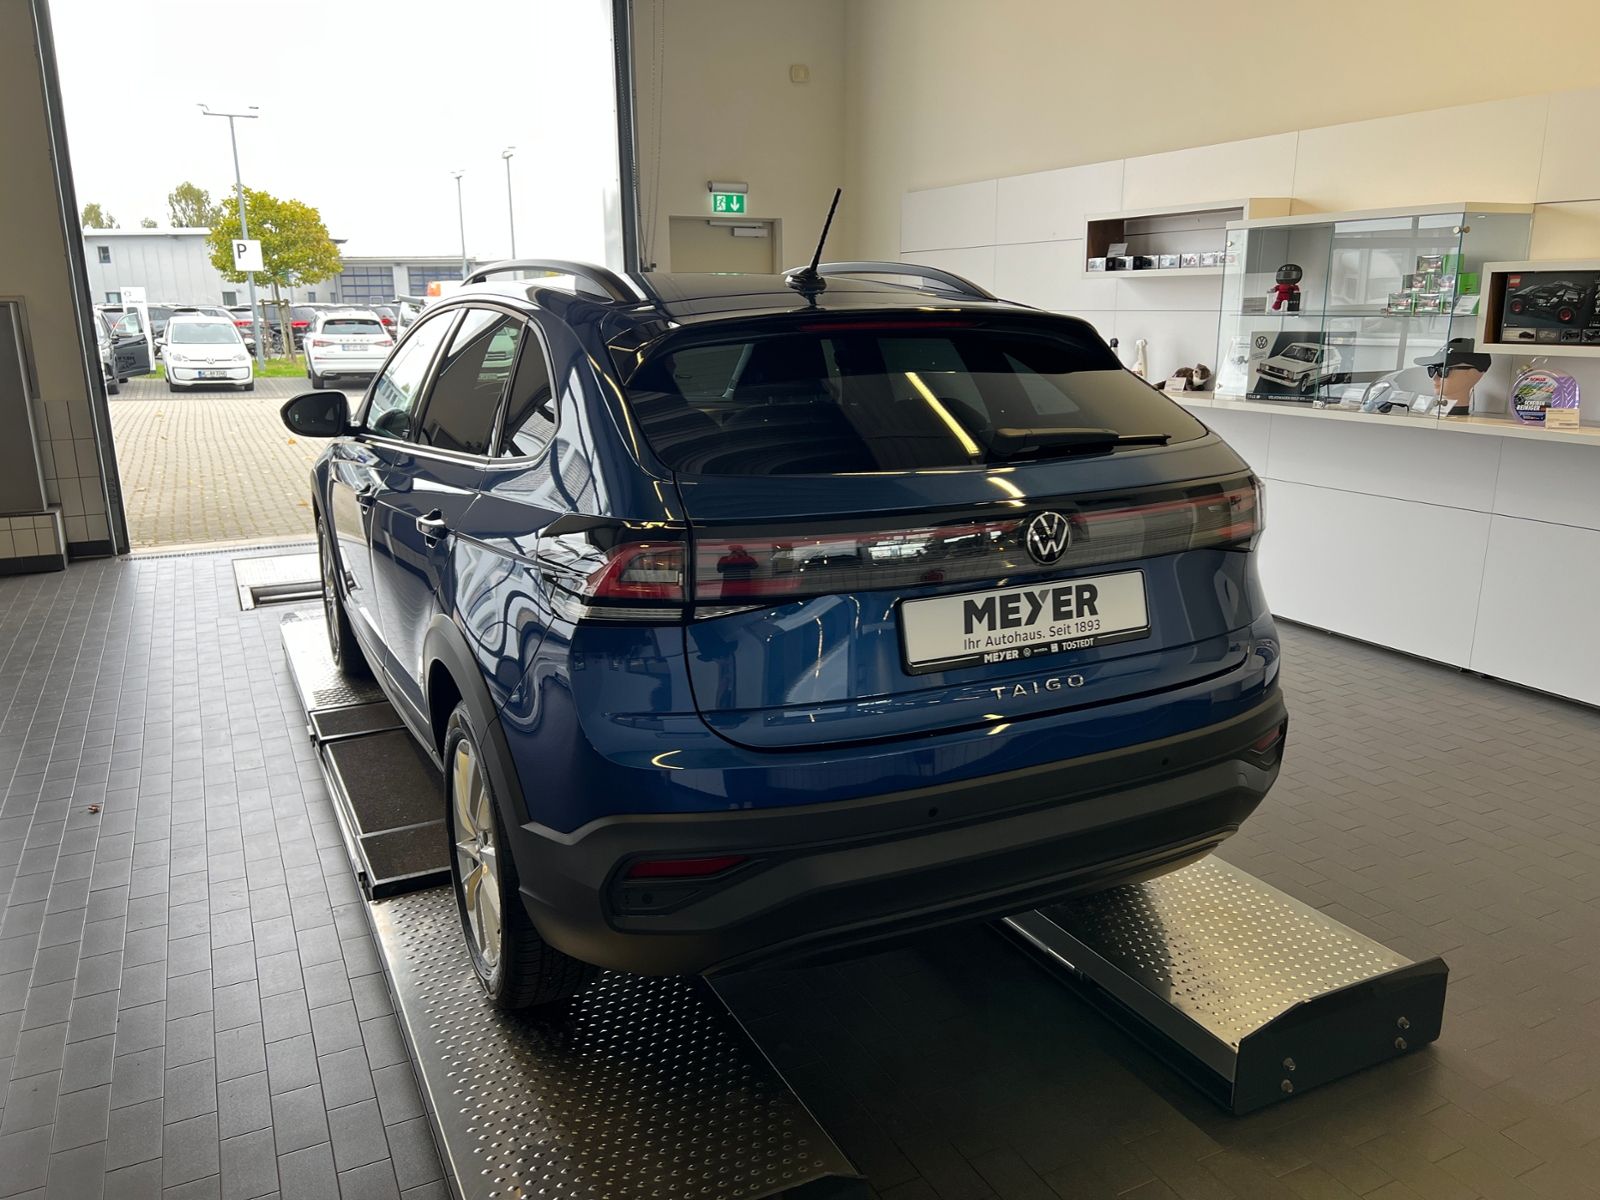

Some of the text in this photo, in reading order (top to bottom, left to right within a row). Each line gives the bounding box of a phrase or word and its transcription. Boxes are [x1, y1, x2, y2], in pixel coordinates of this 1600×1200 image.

[236, 243, 247, 259] P
[963, 584, 1099, 635] MEYER
[964, 619, 1101, 650] Ihr Autohaus. Seit 1893
[984, 649, 1019, 663] MEYER
[1062, 637, 1094, 651] TOSTEDT
[990, 674, 1084, 700] TAIGO
